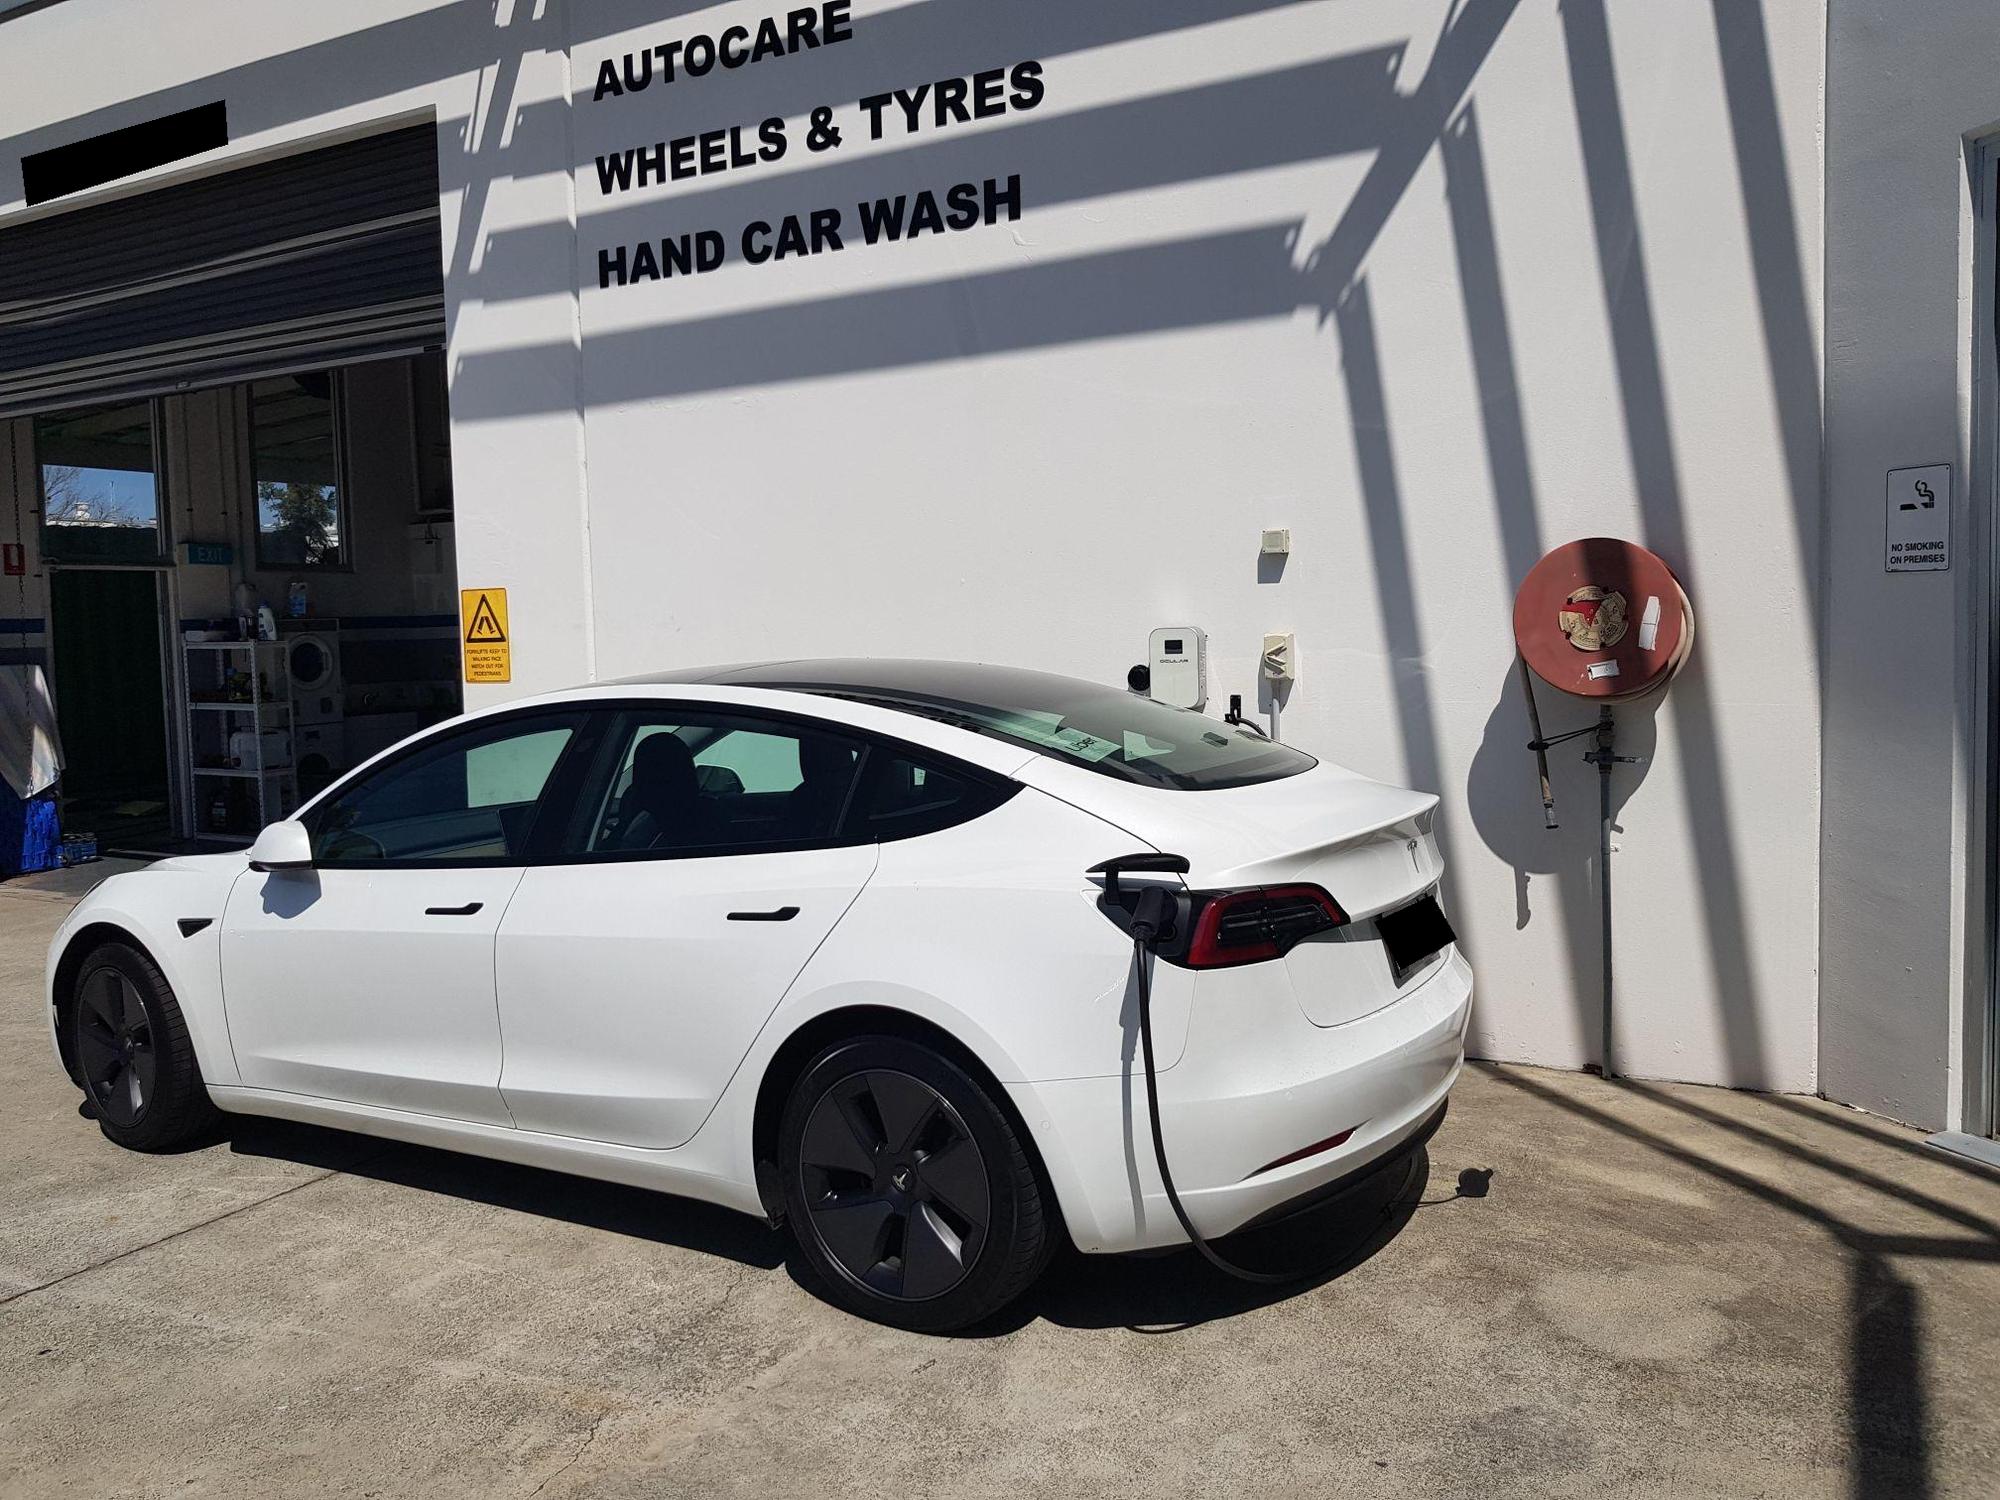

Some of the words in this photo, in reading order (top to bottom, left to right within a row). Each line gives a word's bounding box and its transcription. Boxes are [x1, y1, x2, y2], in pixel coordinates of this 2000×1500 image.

[593, 0, 853, 101] AUTOCARE
[595, 117, 787, 195] WHEELS
[806, 106, 842, 152] &
[859, 60, 1045, 140] TYRES
[598, 229, 725, 289] HAND
[741, 208, 844, 265] CAR
[858, 174, 1022, 245] WASH
[198, 547, 223, 562] EXIT
[1890, 556, 1902, 564] ON
[1903, 554, 1945, 564] PREMISES
[1891, 543, 1903, 552] NO
[1904, 541, 1944, 552] SMOKING
